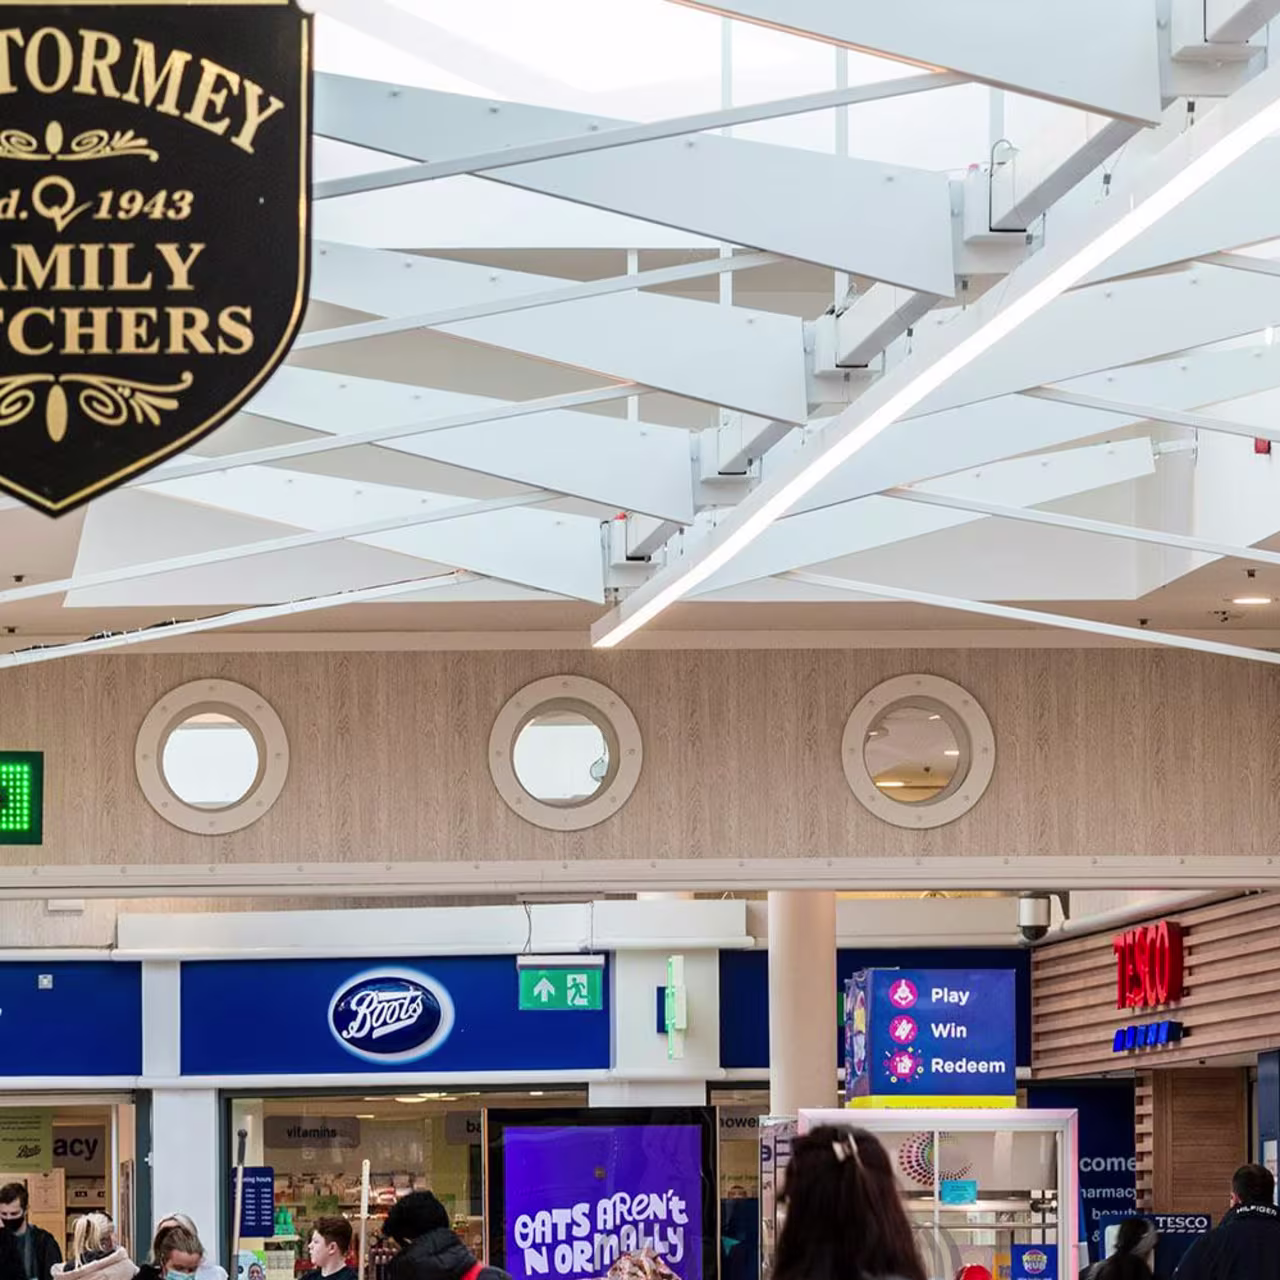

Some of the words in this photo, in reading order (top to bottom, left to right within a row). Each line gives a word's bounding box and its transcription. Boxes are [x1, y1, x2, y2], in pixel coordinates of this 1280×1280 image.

[93, 189, 194, 220] 1943
[0, 306, 254, 356] CHERS
[1111, 920, 1178, 1010] TESCO
[931, 988, 970, 1004] Play
[342, 986, 424, 1039] Boots
[931, 1023, 967, 1038] Win
[931, 1058, 1006, 1073] Redeem
[286, 1128, 337, 1139] vitamins
[1236, 1204, 1278, 1217] HILFIGER
[514, 1202, 591, 1249] OATS
[1155, 1216, 1208, 1229] TESCO
